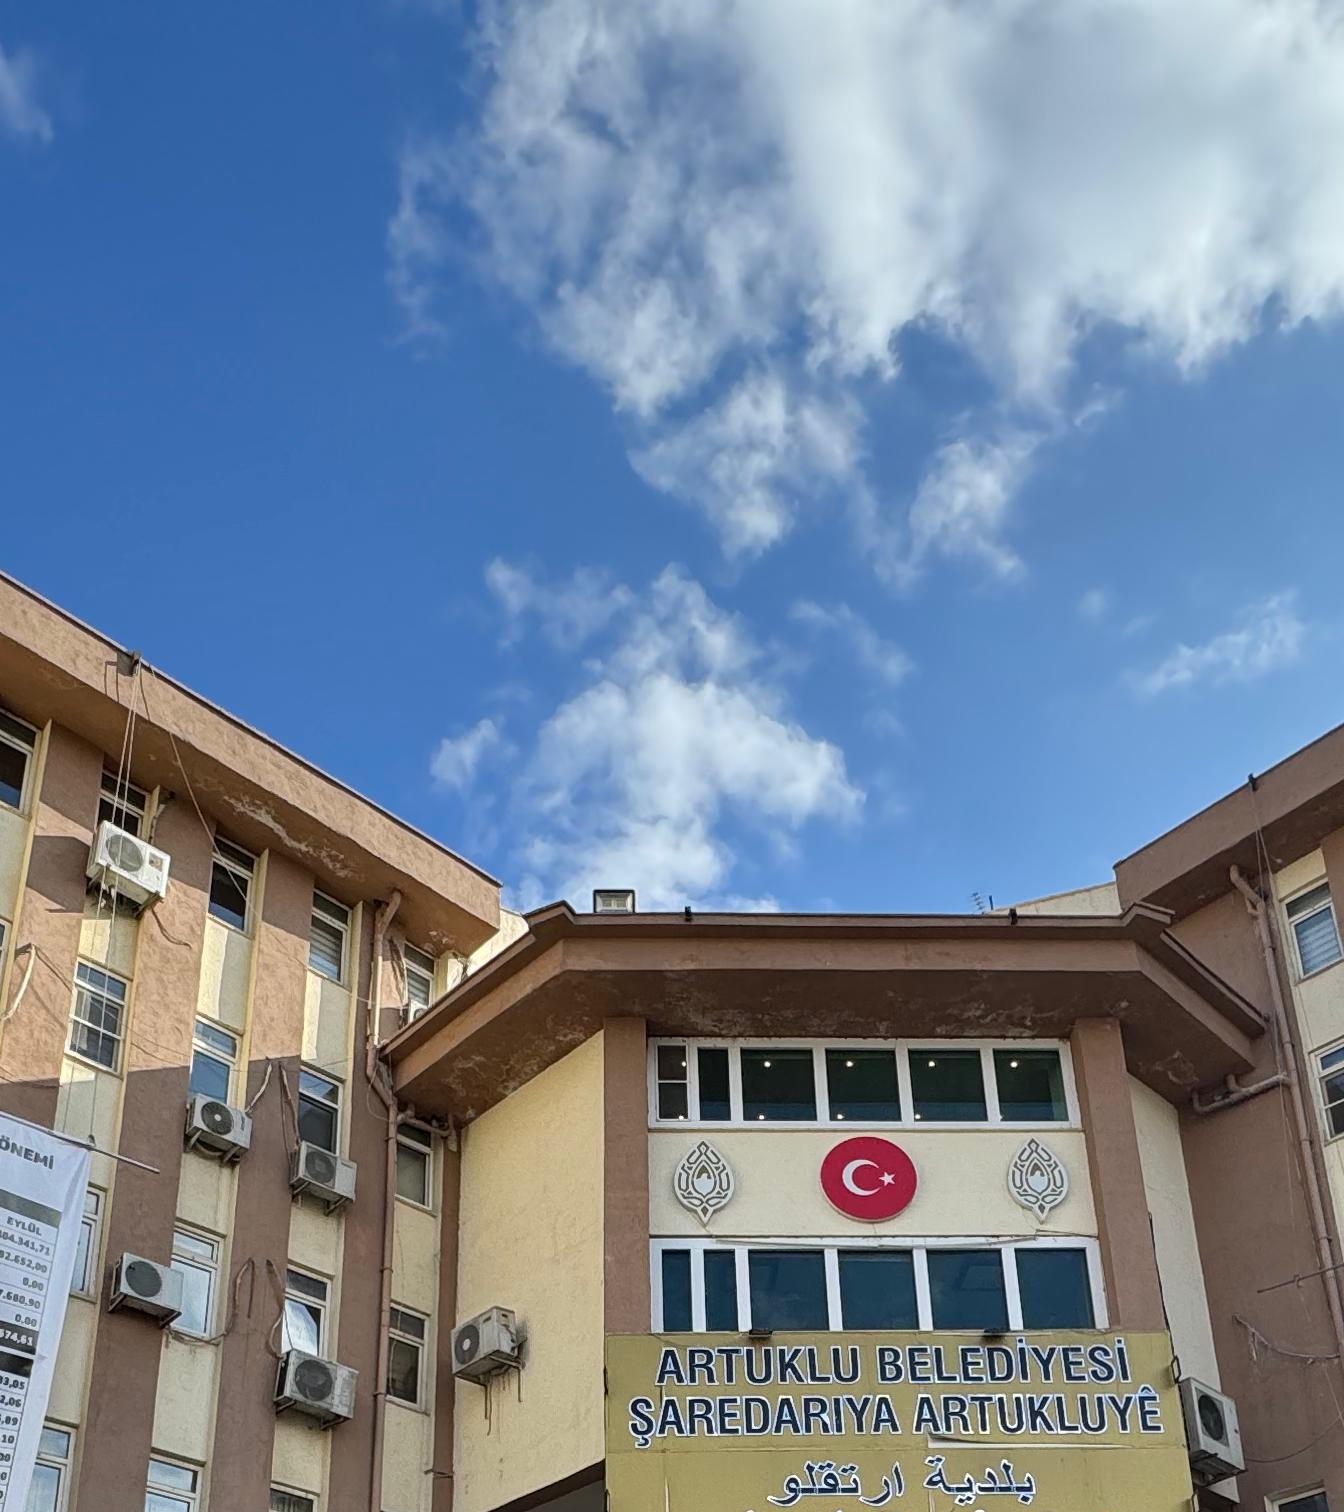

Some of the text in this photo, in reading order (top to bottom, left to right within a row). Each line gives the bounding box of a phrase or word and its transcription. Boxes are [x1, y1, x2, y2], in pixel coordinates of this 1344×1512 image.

[6, 1214, 43, 1236] EYLÜL
[656, 1337, 1132, 1386] ARTUKLU BELEDİYESİ
[628, 1385, 1164, 1449] ŞAREDARIYA ARTUKLUYÊ
[922, 1455, 1037, 1507] بلدية
